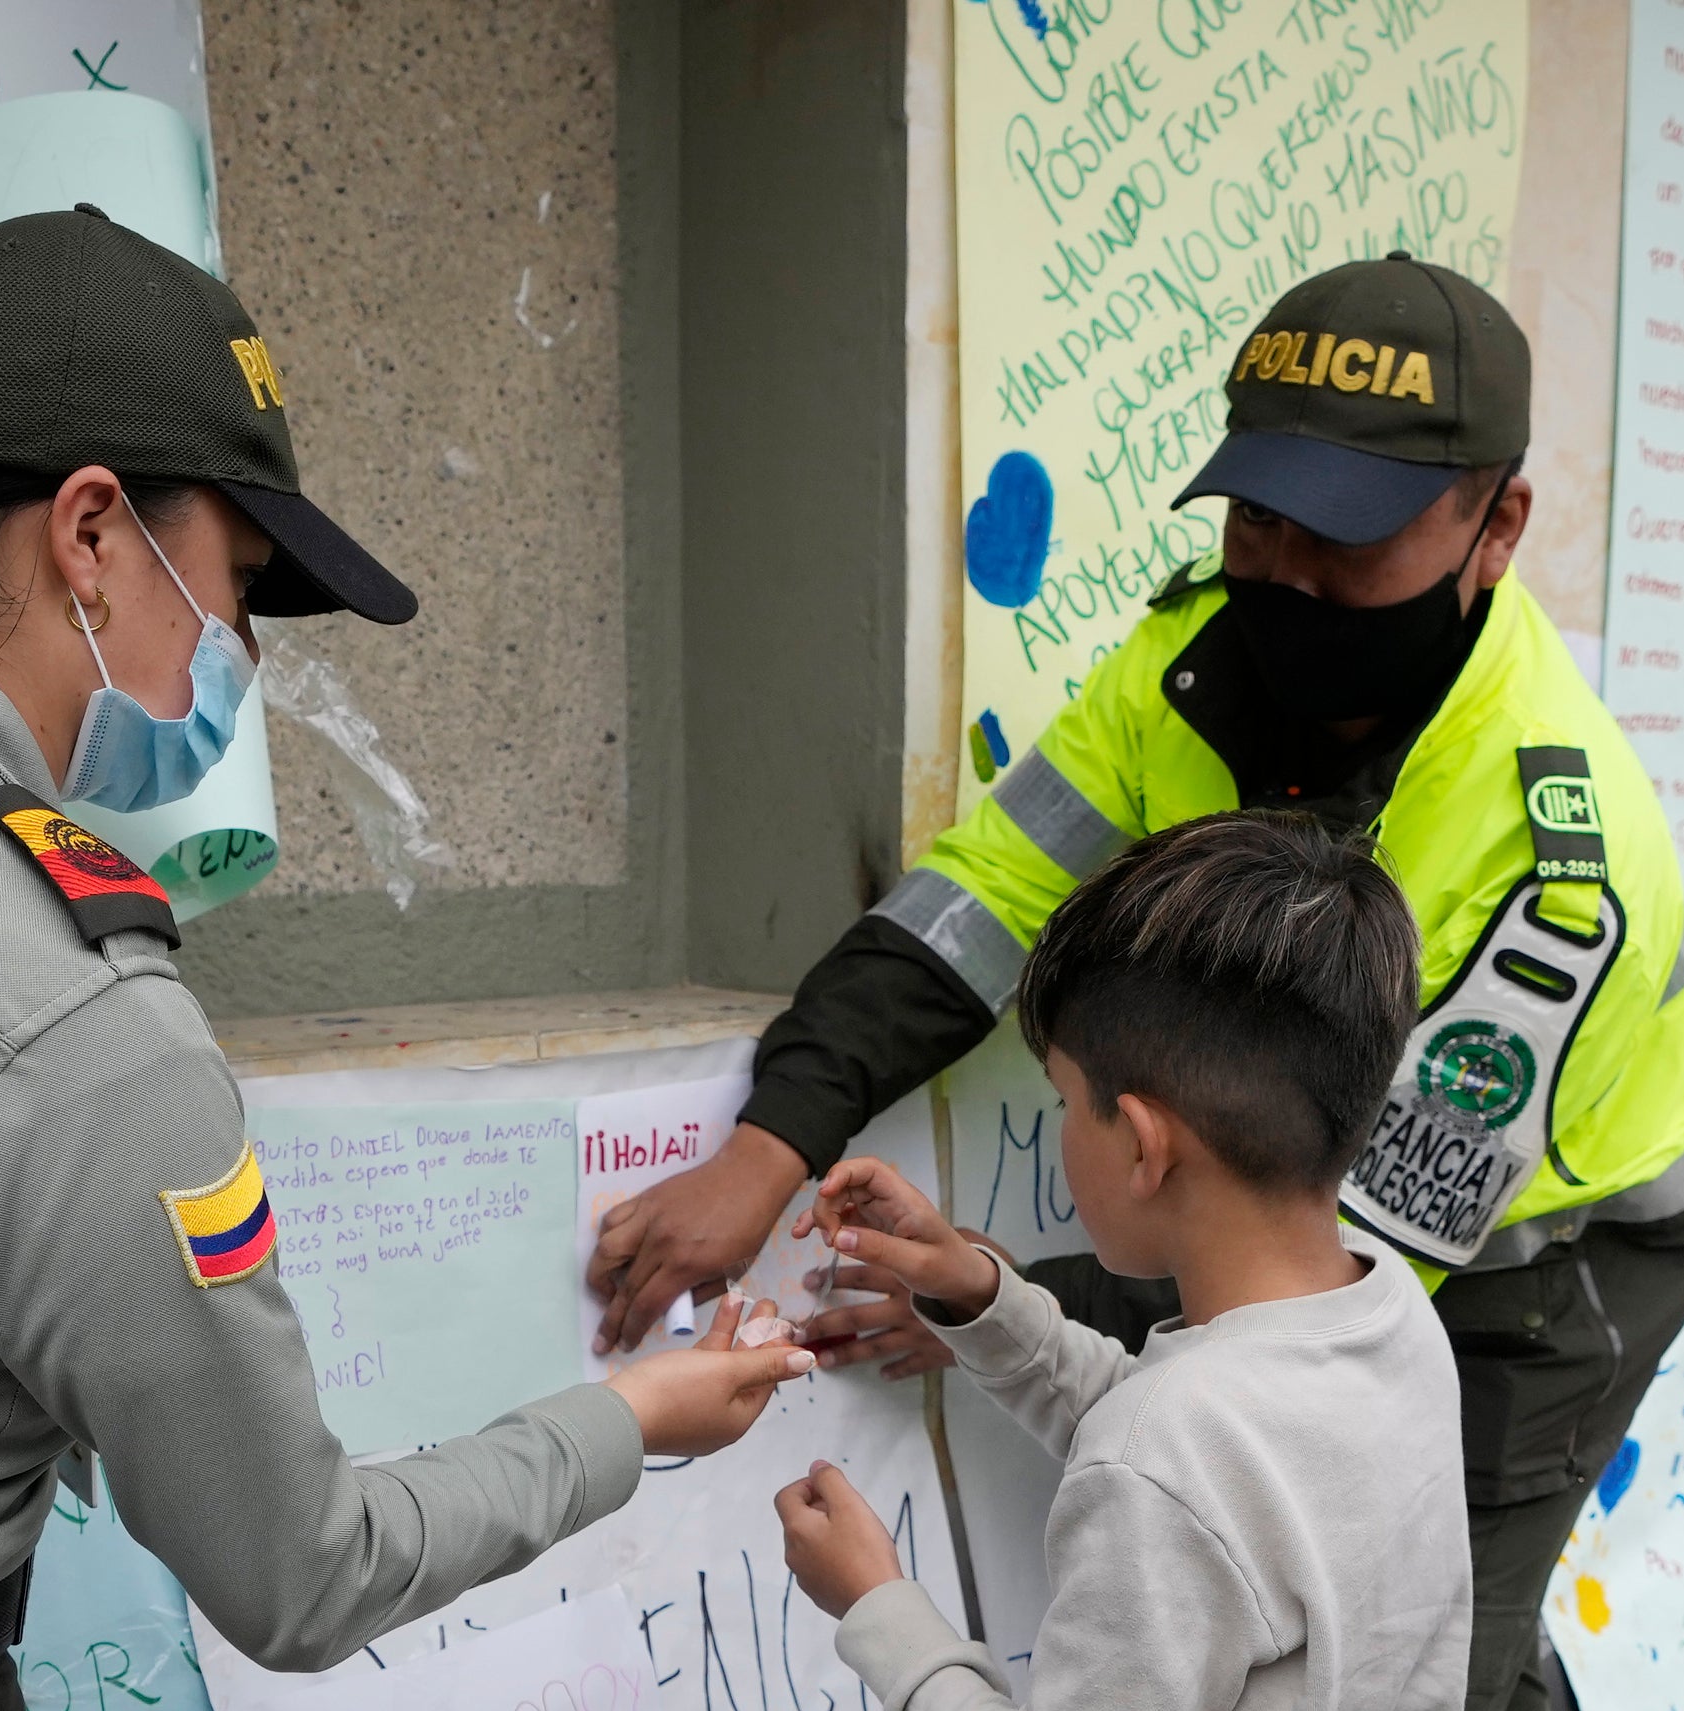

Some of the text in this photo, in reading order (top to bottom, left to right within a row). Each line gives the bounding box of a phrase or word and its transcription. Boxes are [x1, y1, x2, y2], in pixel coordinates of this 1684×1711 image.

[1005, 40, 1162, 226] POSIBLE
[1158, 49, 1288, 176] EXISTA
[1235, 330, 1436, 406] POLICIA
[1536, 858, 1608, 880] 09-2021
[253, 1135, 319, 1165] guito
[330, 1130, 406, 1160] DANIEL
[263, 1162, 334, 1190] erdida
[345, 1163, 410, 1190] espero
[417, 1155, 447, 1182] que
[463, 1146, 510, 1167] donde
[1369, 1100, 1496, 1199] FANCIA
[1351, 1146, 1495, 1249] OLESCENCIA
